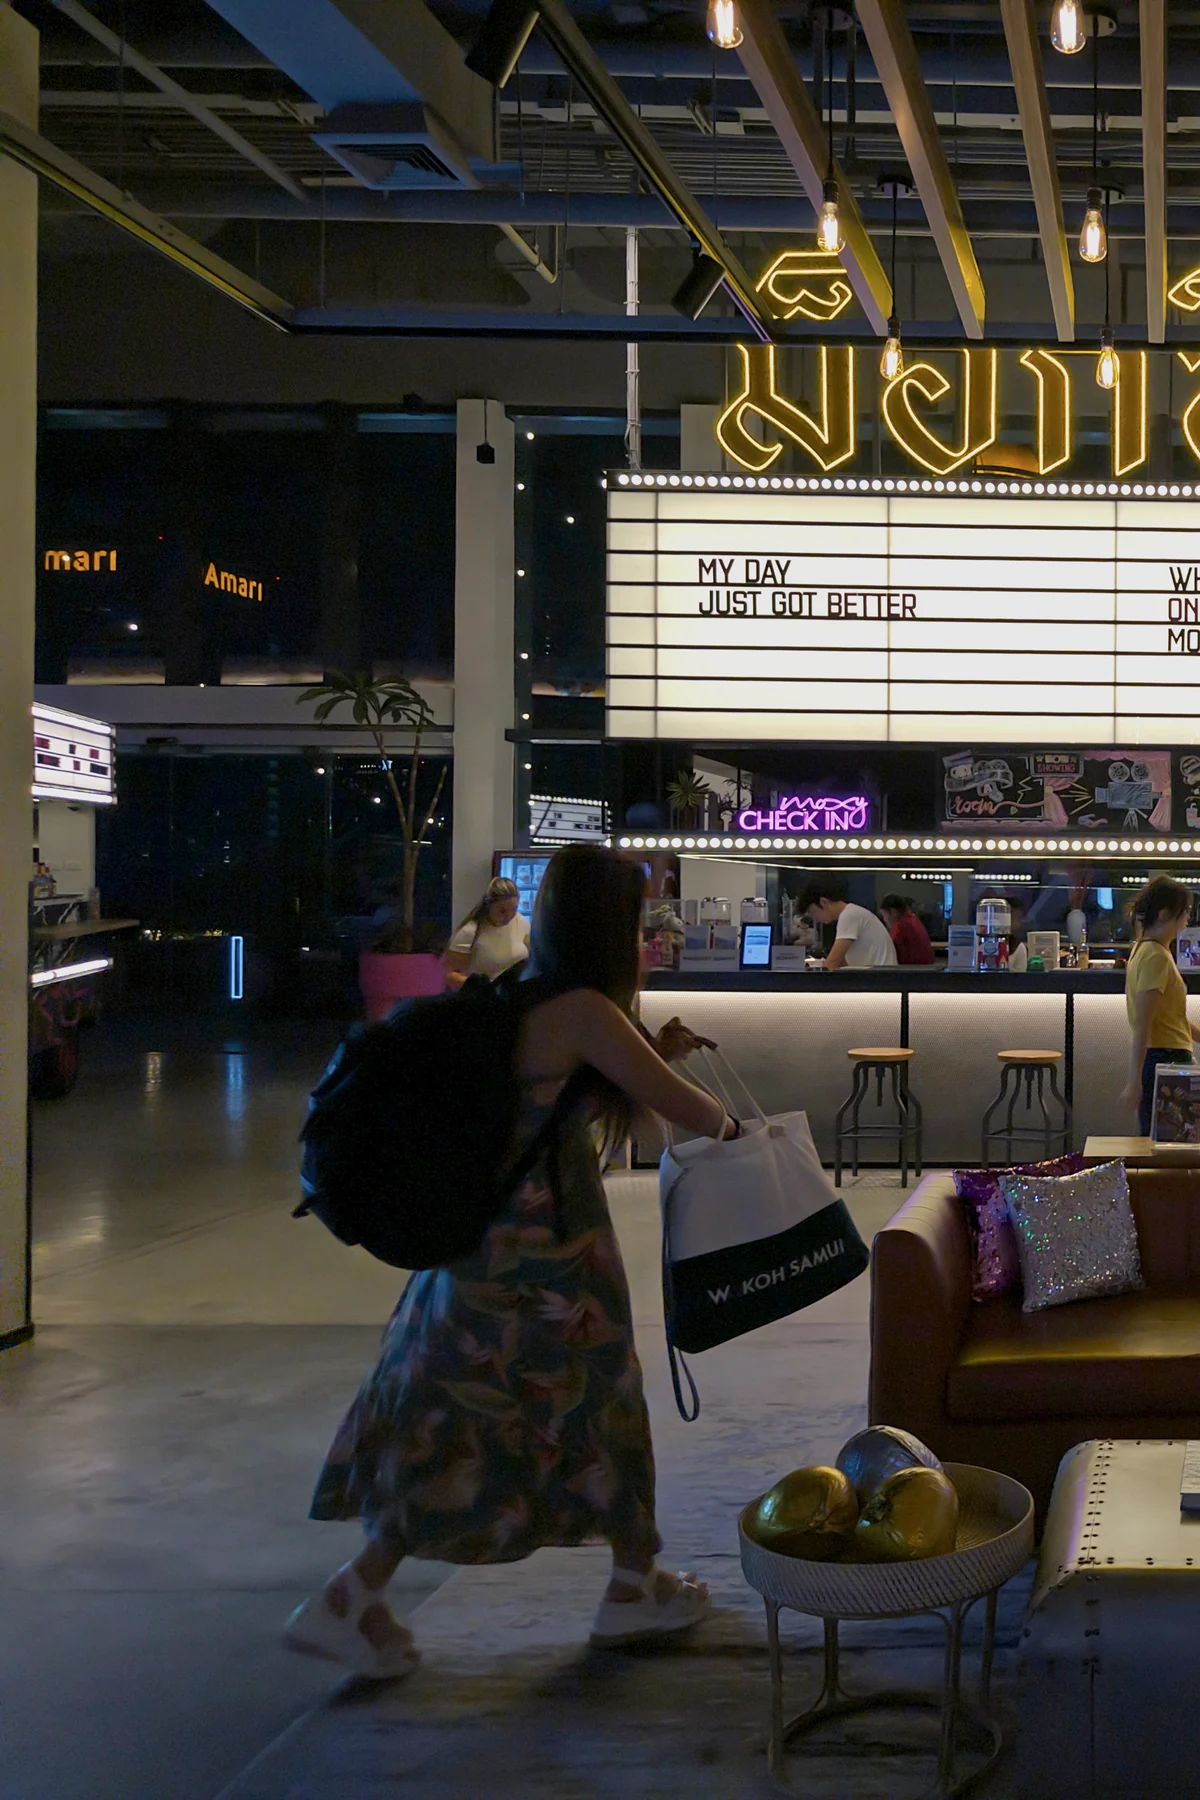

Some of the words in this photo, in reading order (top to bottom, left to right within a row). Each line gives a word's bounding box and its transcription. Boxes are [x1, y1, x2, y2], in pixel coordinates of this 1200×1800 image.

[44, 549, 117, 571] mari
[698, 557, 735, 584] MY
[745, 558, 792, 584] DAY
[204, 561, 263, 602] Amari
[698, 590, 762, 616] JUST
[771, 591, 818, 617] GOT
[827, 592, 917, 618] BETTER
[739, 810, 819, 830] CHECK
[824, 811, 849, 831] IN
[708, 1285, 730, 1305] W
[742, 1267, 785, 1295] KOH
[789, 1238, 845, 1277] SAMUI
